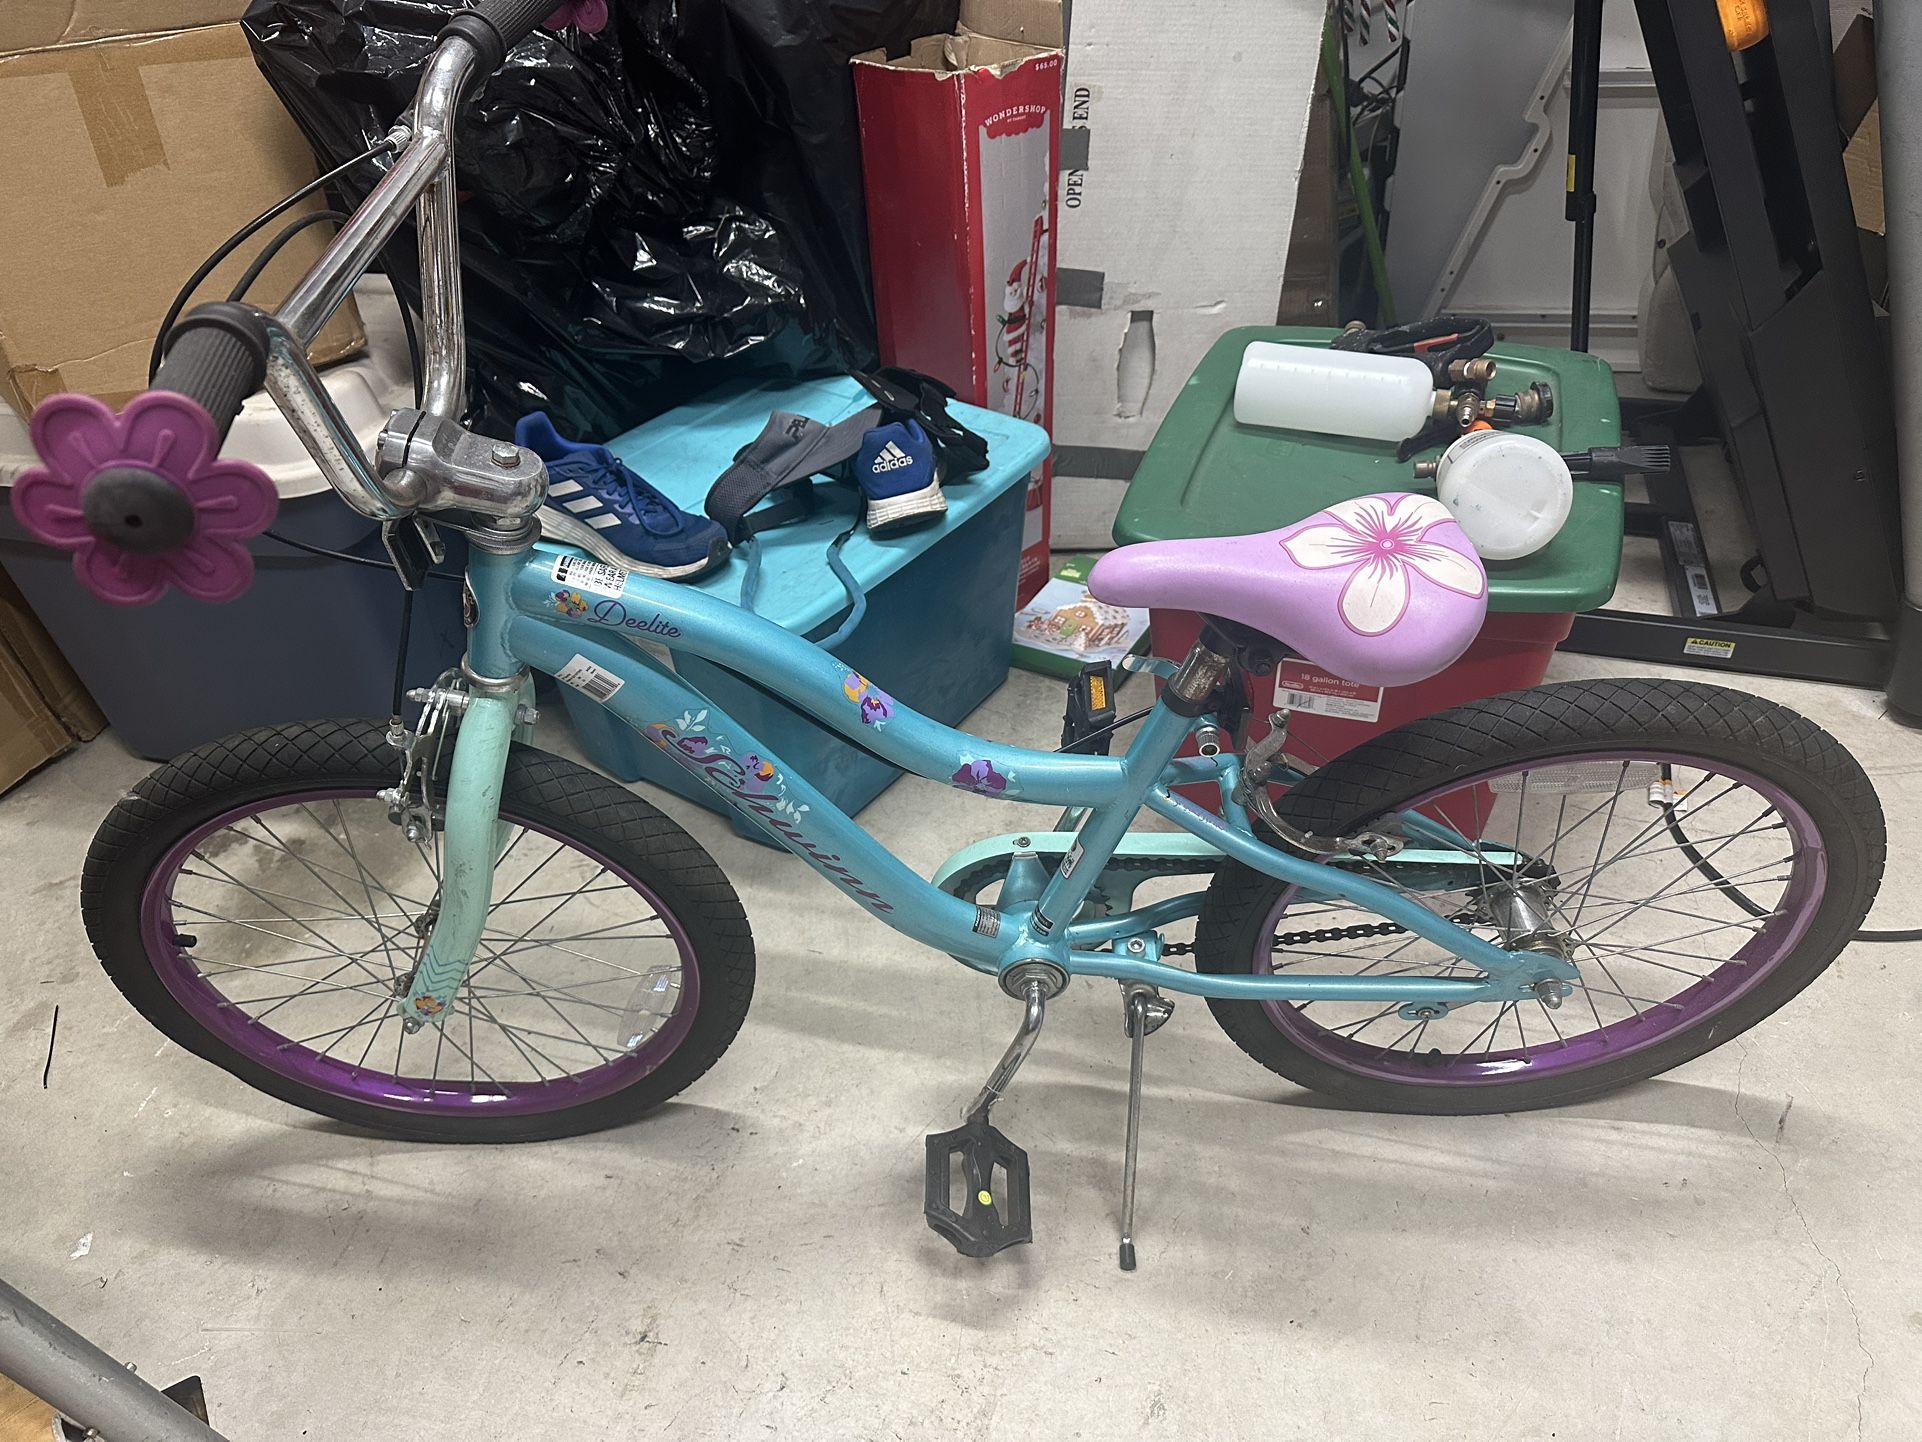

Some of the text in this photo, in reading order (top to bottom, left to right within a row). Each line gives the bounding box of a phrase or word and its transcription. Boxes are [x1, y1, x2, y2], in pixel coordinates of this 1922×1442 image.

[1035, 59, 1058, 71] $65.00
[984, 104, 1046, 126] WONDERSHOP
[1073, 87, 1090, 121] END
[1065, 169, 1084, 208] OPEN
[872, 455, 914, 474] adidas
[587, 600, 682, 638] Deelite
[1699, 640, 1732, 648] CAUTION
[1301, 672, 1360, 688] 18 gallon tote
[661, 729, 895, 914] Schwinn
